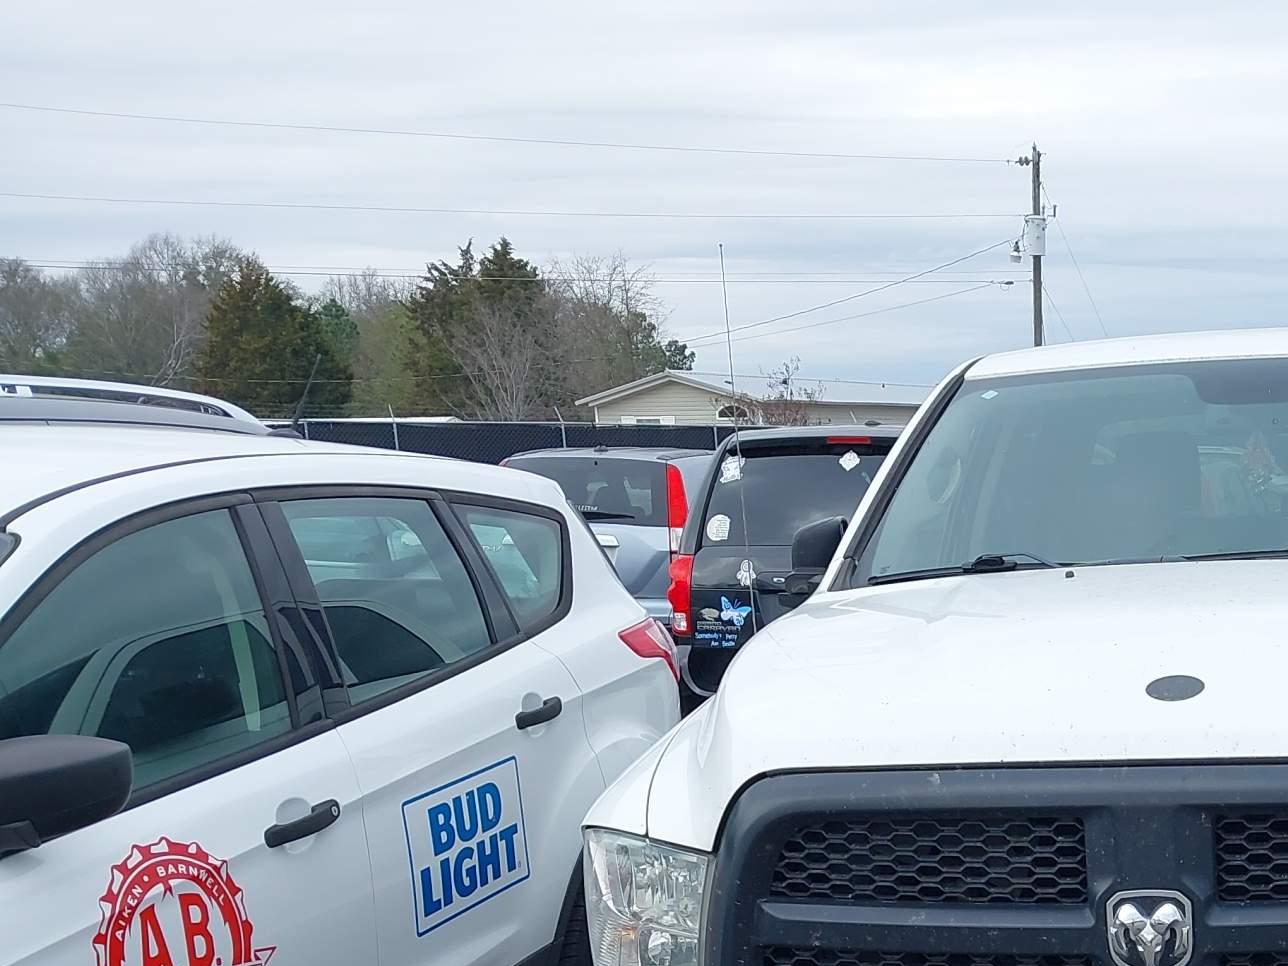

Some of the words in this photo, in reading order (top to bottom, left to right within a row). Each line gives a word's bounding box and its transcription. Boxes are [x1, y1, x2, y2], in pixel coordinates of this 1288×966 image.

[427, 782, 502, 857] BUD
[115, 884, 143, 942] AIKEN
[156, 863, 226, 907] BARNWELL
[420, 823, 519, 918] LIGHT
